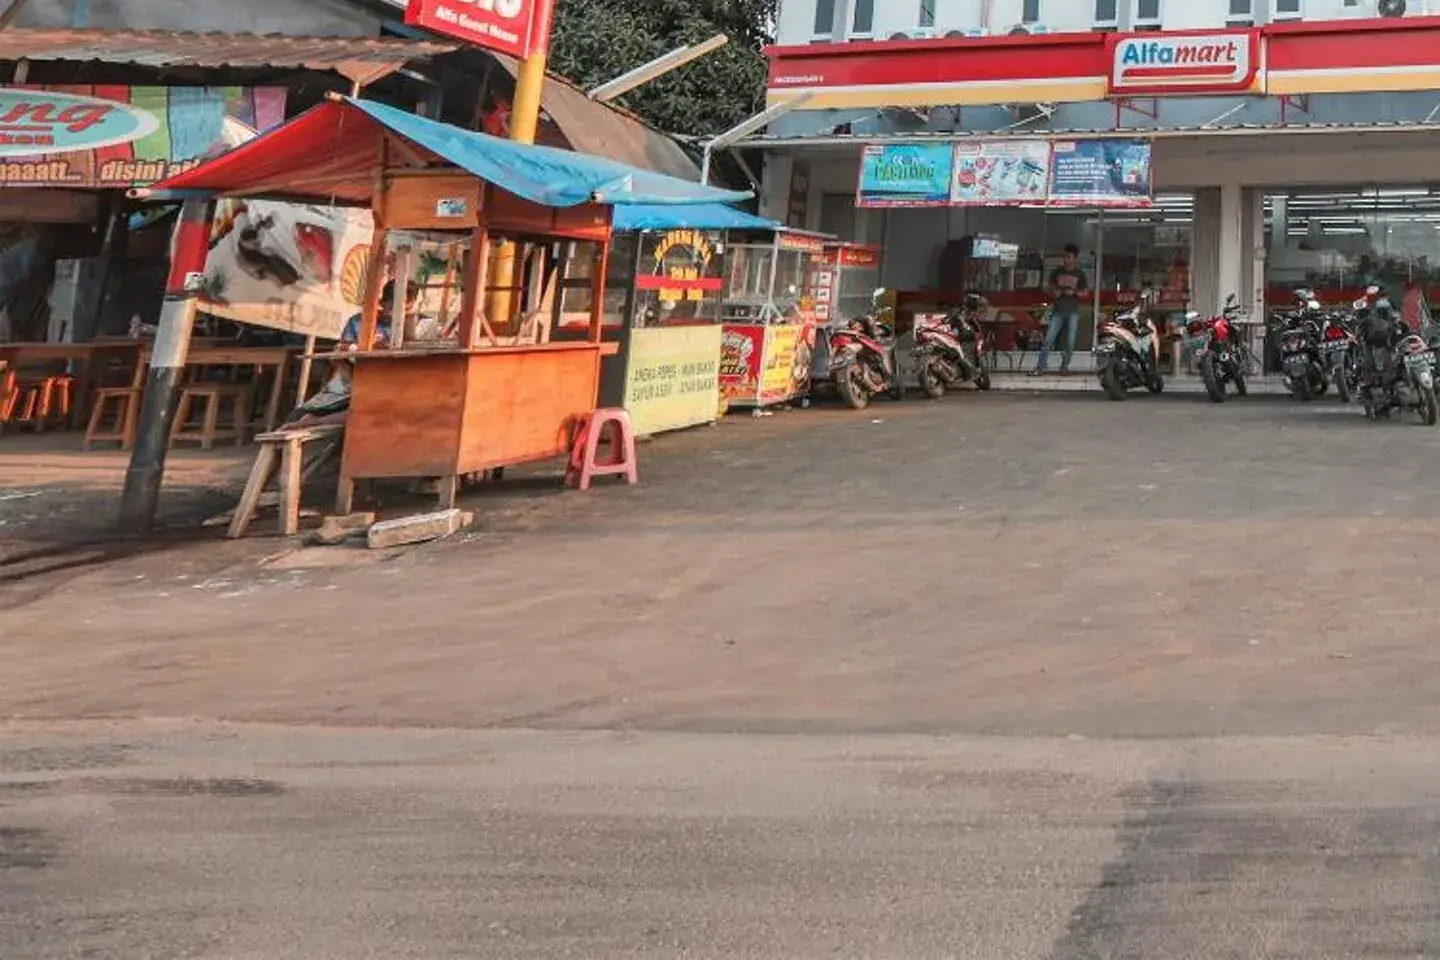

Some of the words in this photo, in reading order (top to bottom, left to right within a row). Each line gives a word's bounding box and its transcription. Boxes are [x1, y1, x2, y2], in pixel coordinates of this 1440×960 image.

[1122, 41, 1238, 64] Alfamart
[0, 102, 114, 132] ng
[101, 158, 164, 181] disini
